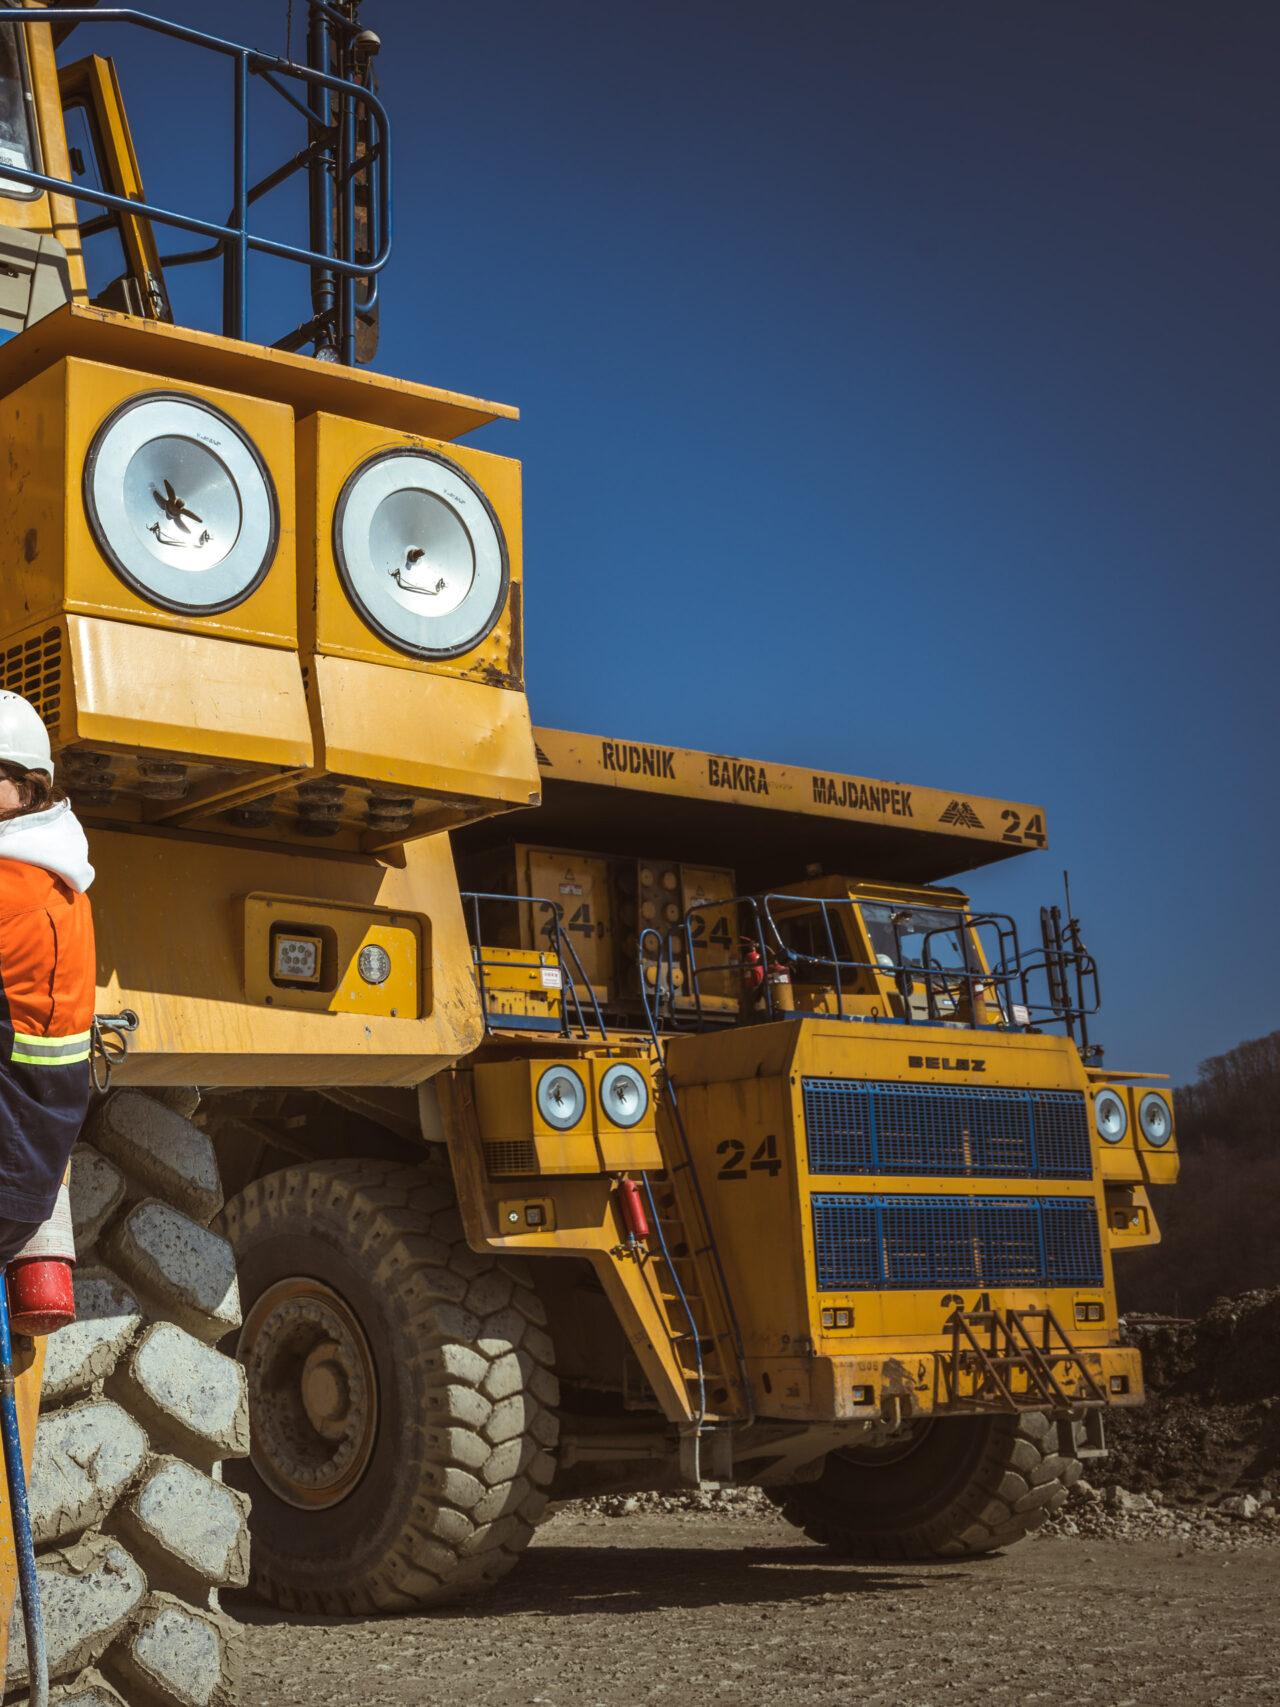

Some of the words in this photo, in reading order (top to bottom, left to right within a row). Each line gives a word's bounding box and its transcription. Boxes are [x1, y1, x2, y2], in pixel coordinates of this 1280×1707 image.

[602, 741, 676, 780] RUDNIK
[708, 758, 769, 795] BAKRA
[812, 775, 914, 818] MAJDANPEK
[1001, 808, 1046, 848] 24
[539, 902, 595, 939] 24
[687, 914, 733, 950] 24
[908, 1055, 986, 1073] BELAZ
[716, 1134, 782, 1181] 24
[940, 1292, 995, 1335] 24
